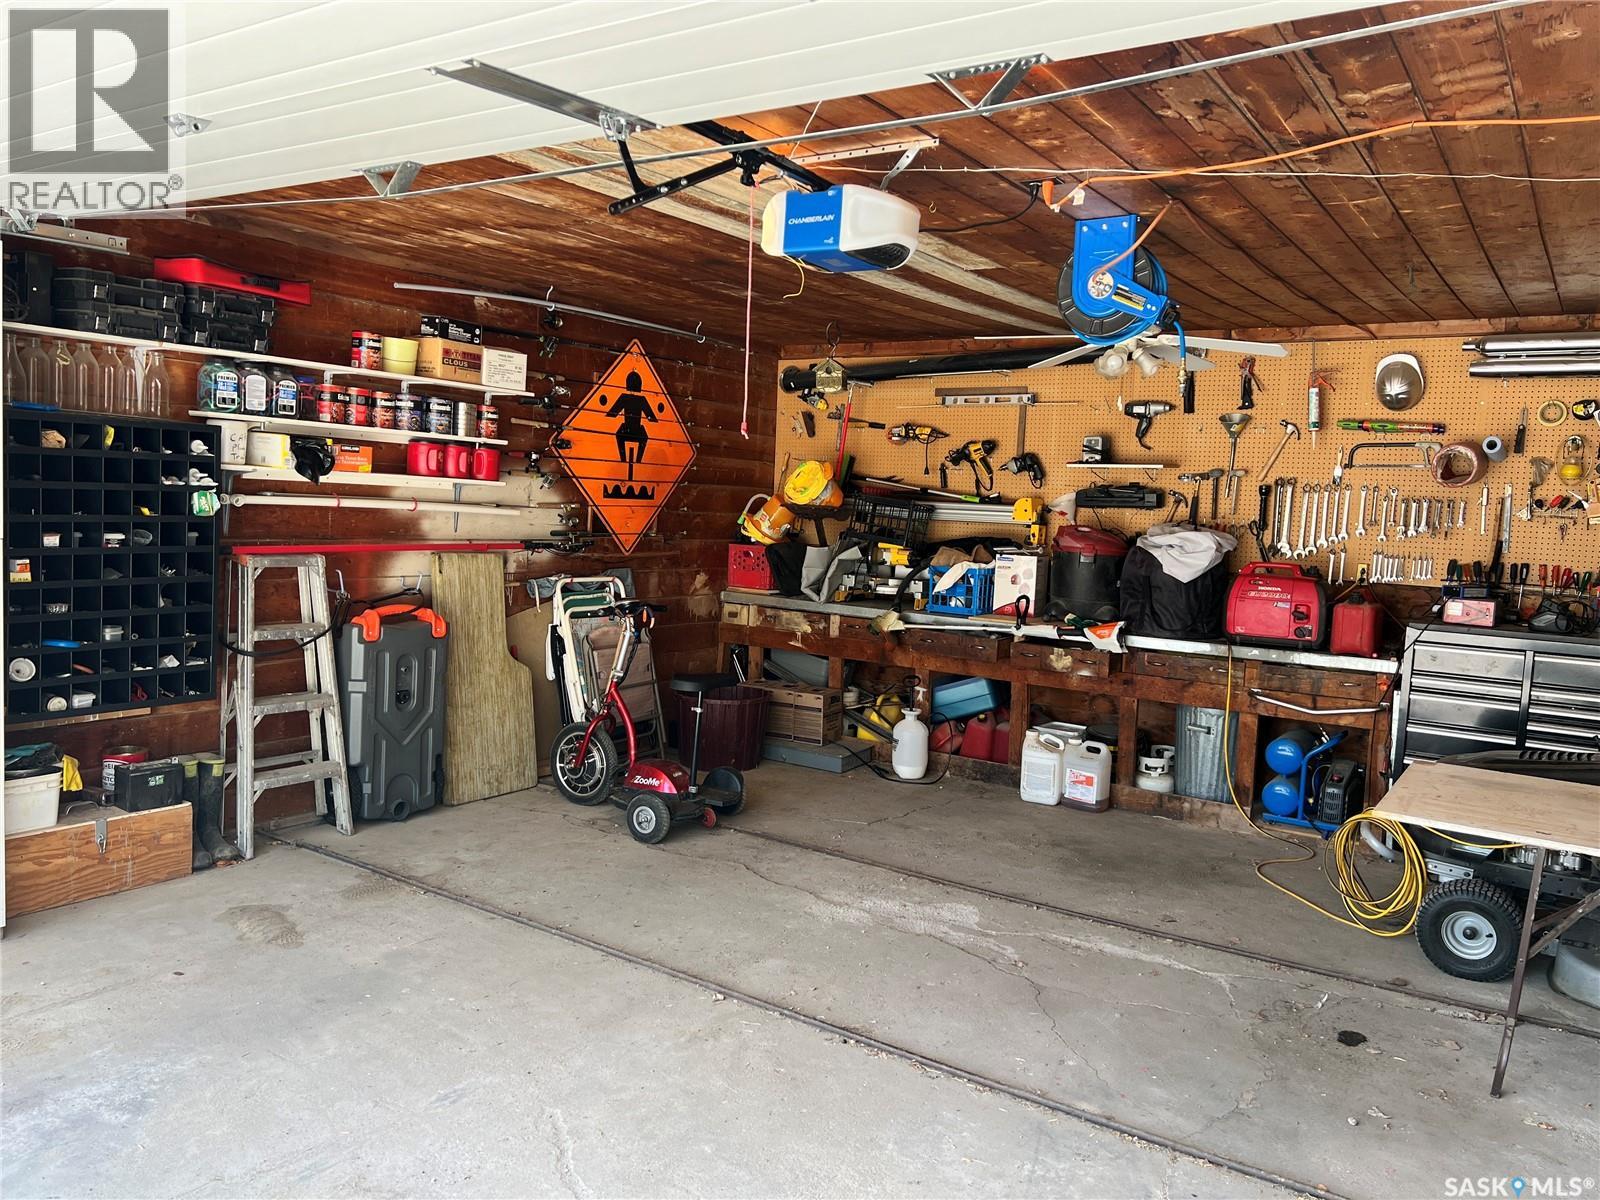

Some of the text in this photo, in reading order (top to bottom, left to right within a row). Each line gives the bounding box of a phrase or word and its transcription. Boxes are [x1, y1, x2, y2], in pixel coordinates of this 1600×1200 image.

[788, 214, 835, 225] CHAMBERLAIN
[443, 358, 468, 368] CLOUS
[633, 775, 660, 787] ZooMe
